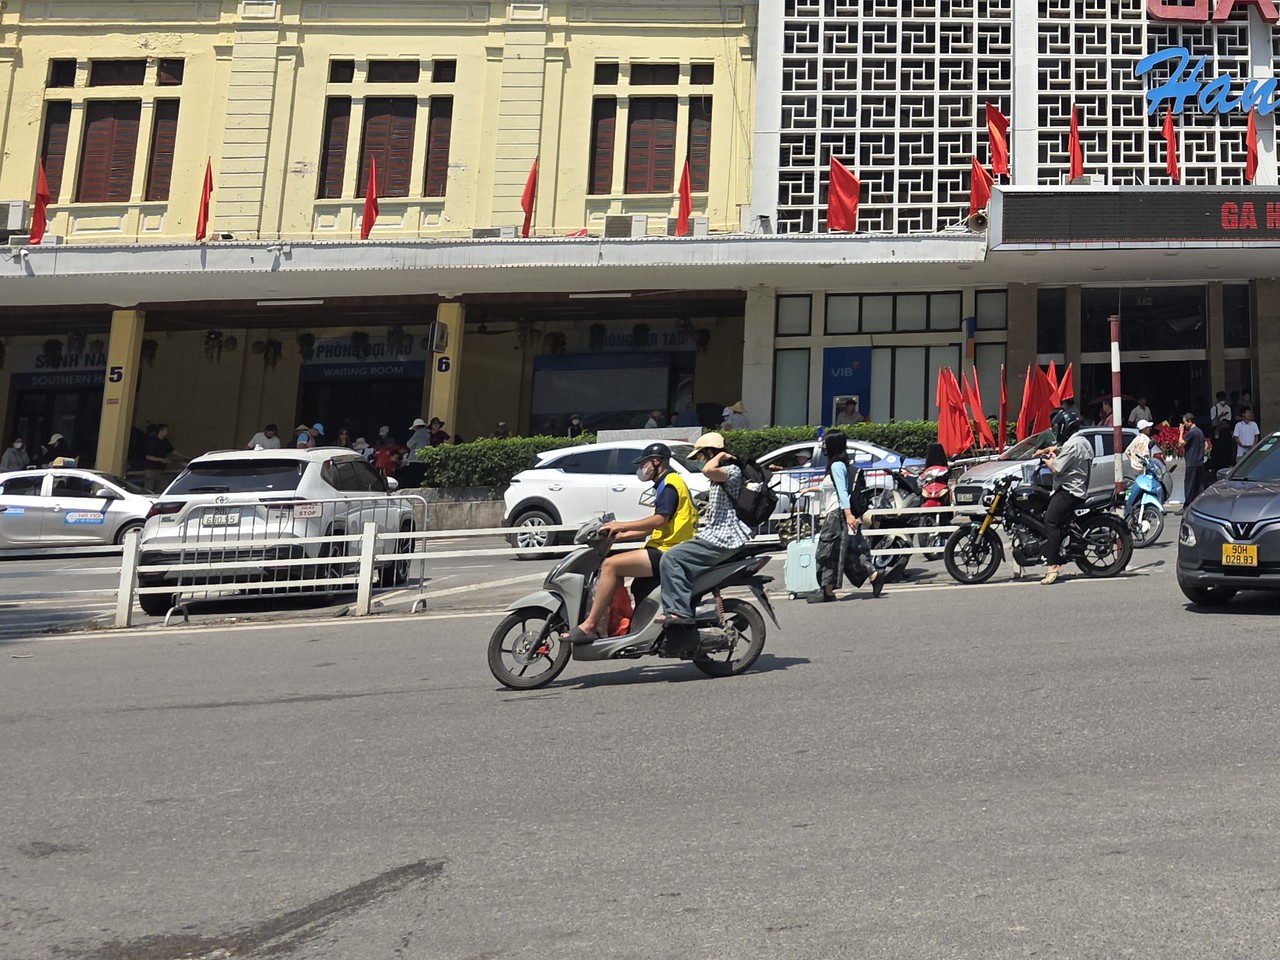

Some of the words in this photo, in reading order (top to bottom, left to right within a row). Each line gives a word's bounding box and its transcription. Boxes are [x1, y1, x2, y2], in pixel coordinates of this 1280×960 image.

[1220, 201, 1258, 230] GA
[438, 357, 451, 372] 6
[109, 367, 123, 382] 5
[323, 368, 370, 380] WAITING
[371, 366, 405, 378] ROOM
[831, 367, 853, 378] VIB
[31, 374, 92, 386] SOUTHERN
